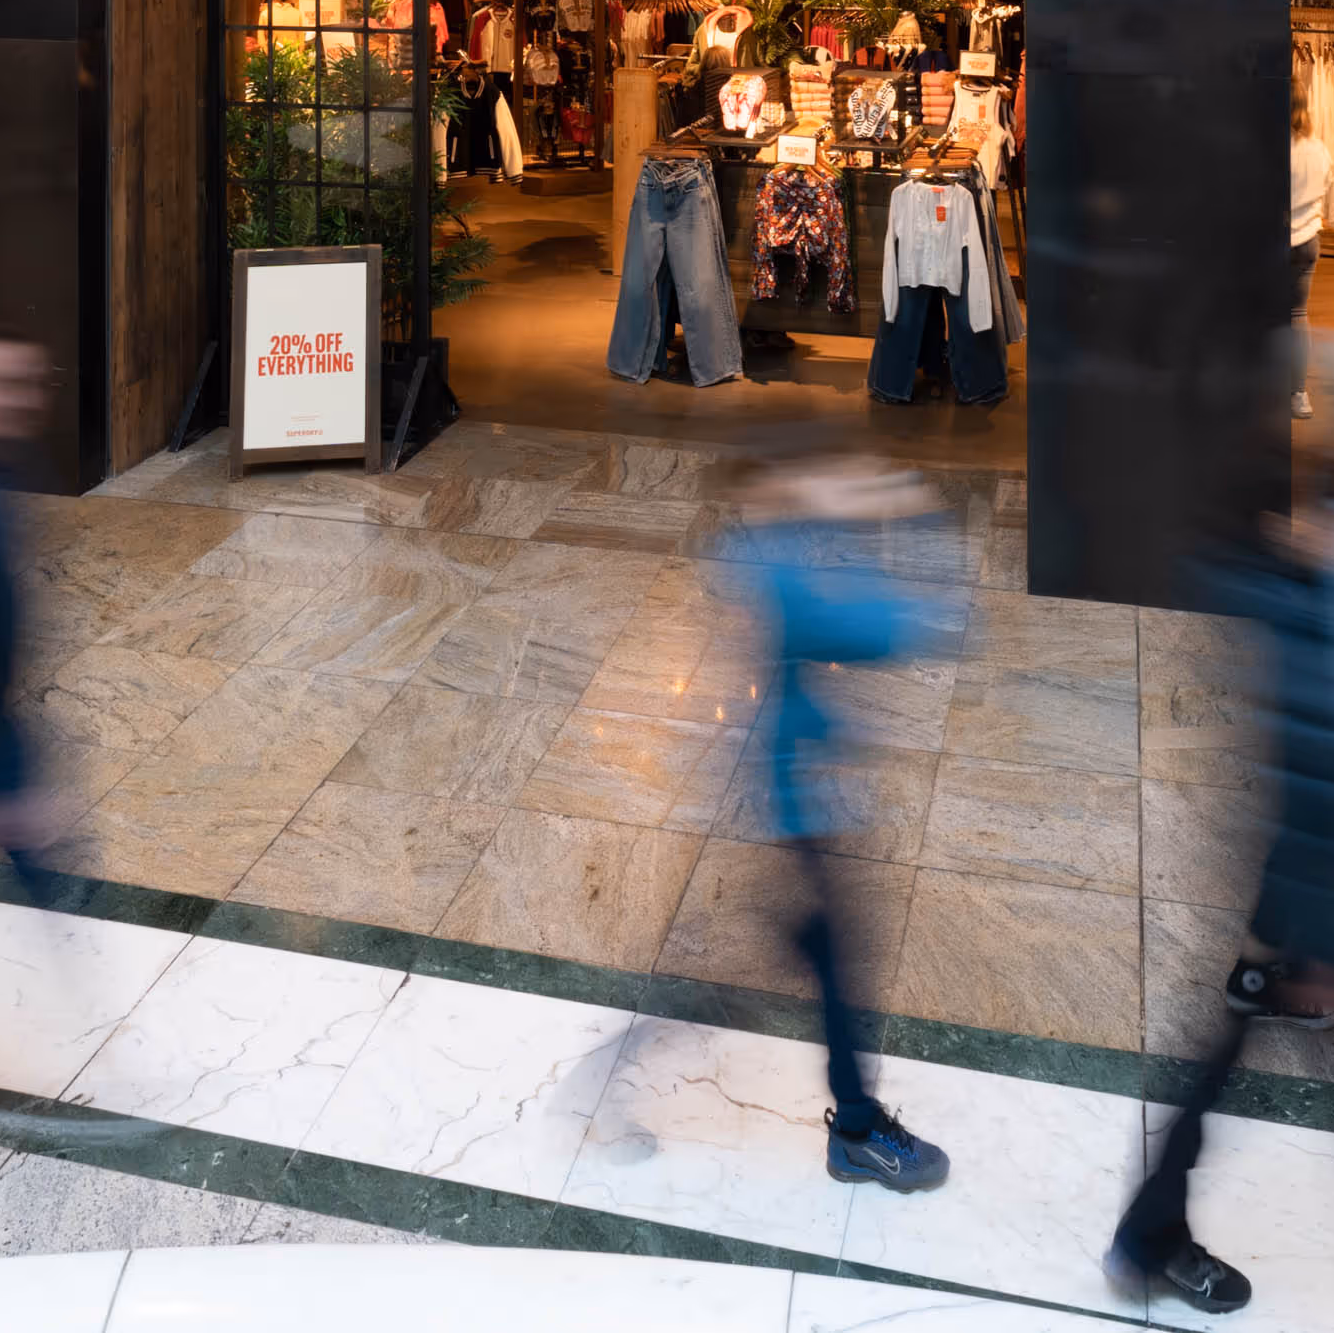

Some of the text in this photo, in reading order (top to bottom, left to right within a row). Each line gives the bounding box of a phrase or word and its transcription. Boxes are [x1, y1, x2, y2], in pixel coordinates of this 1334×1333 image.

[270, 332, 343, 356] 20% OFF
[257, 352, 354, 376] EVERYTHING
